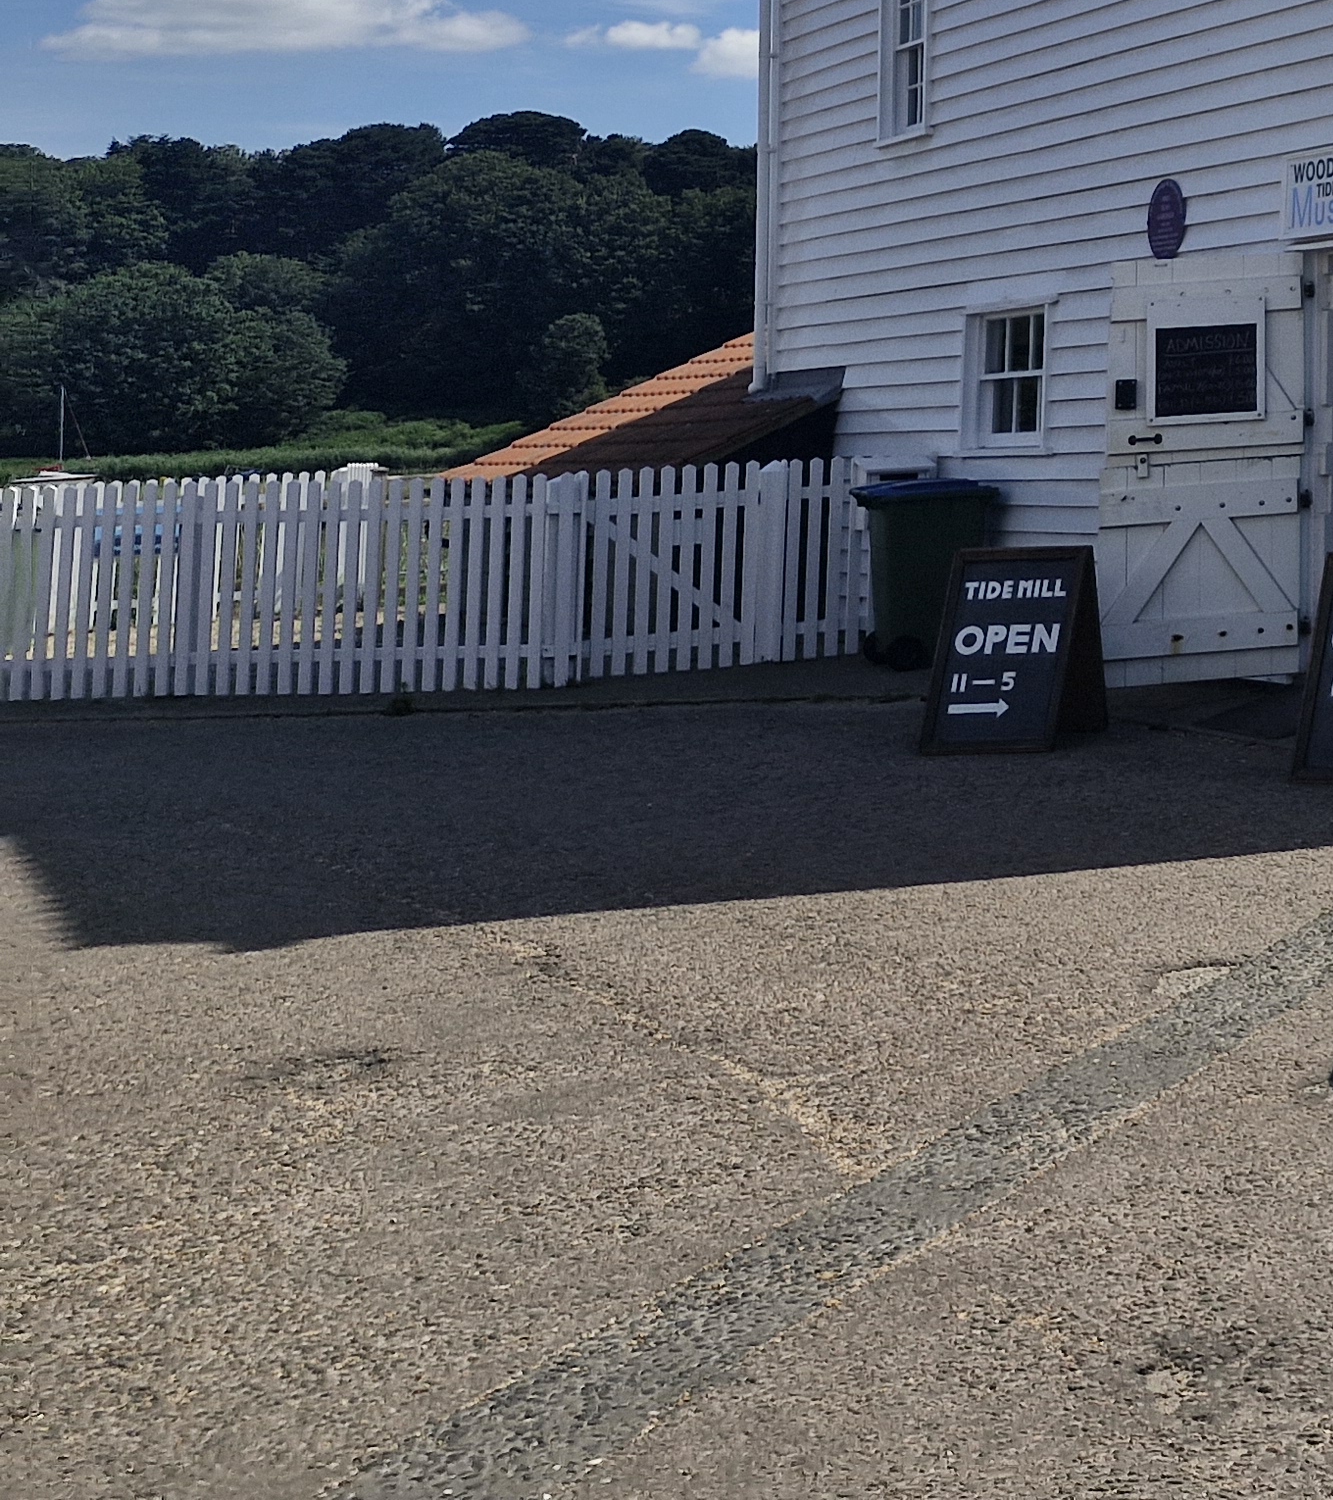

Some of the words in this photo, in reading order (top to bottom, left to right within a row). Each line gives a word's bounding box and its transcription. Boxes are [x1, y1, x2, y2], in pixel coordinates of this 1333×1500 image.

[1165, 331, 1250, 353] ADMISSION
[965, 580, 1013, 600] TIDE
[1018, 578, 1066, 598] MILL
[955, 623, 1060, 656] OPEN
